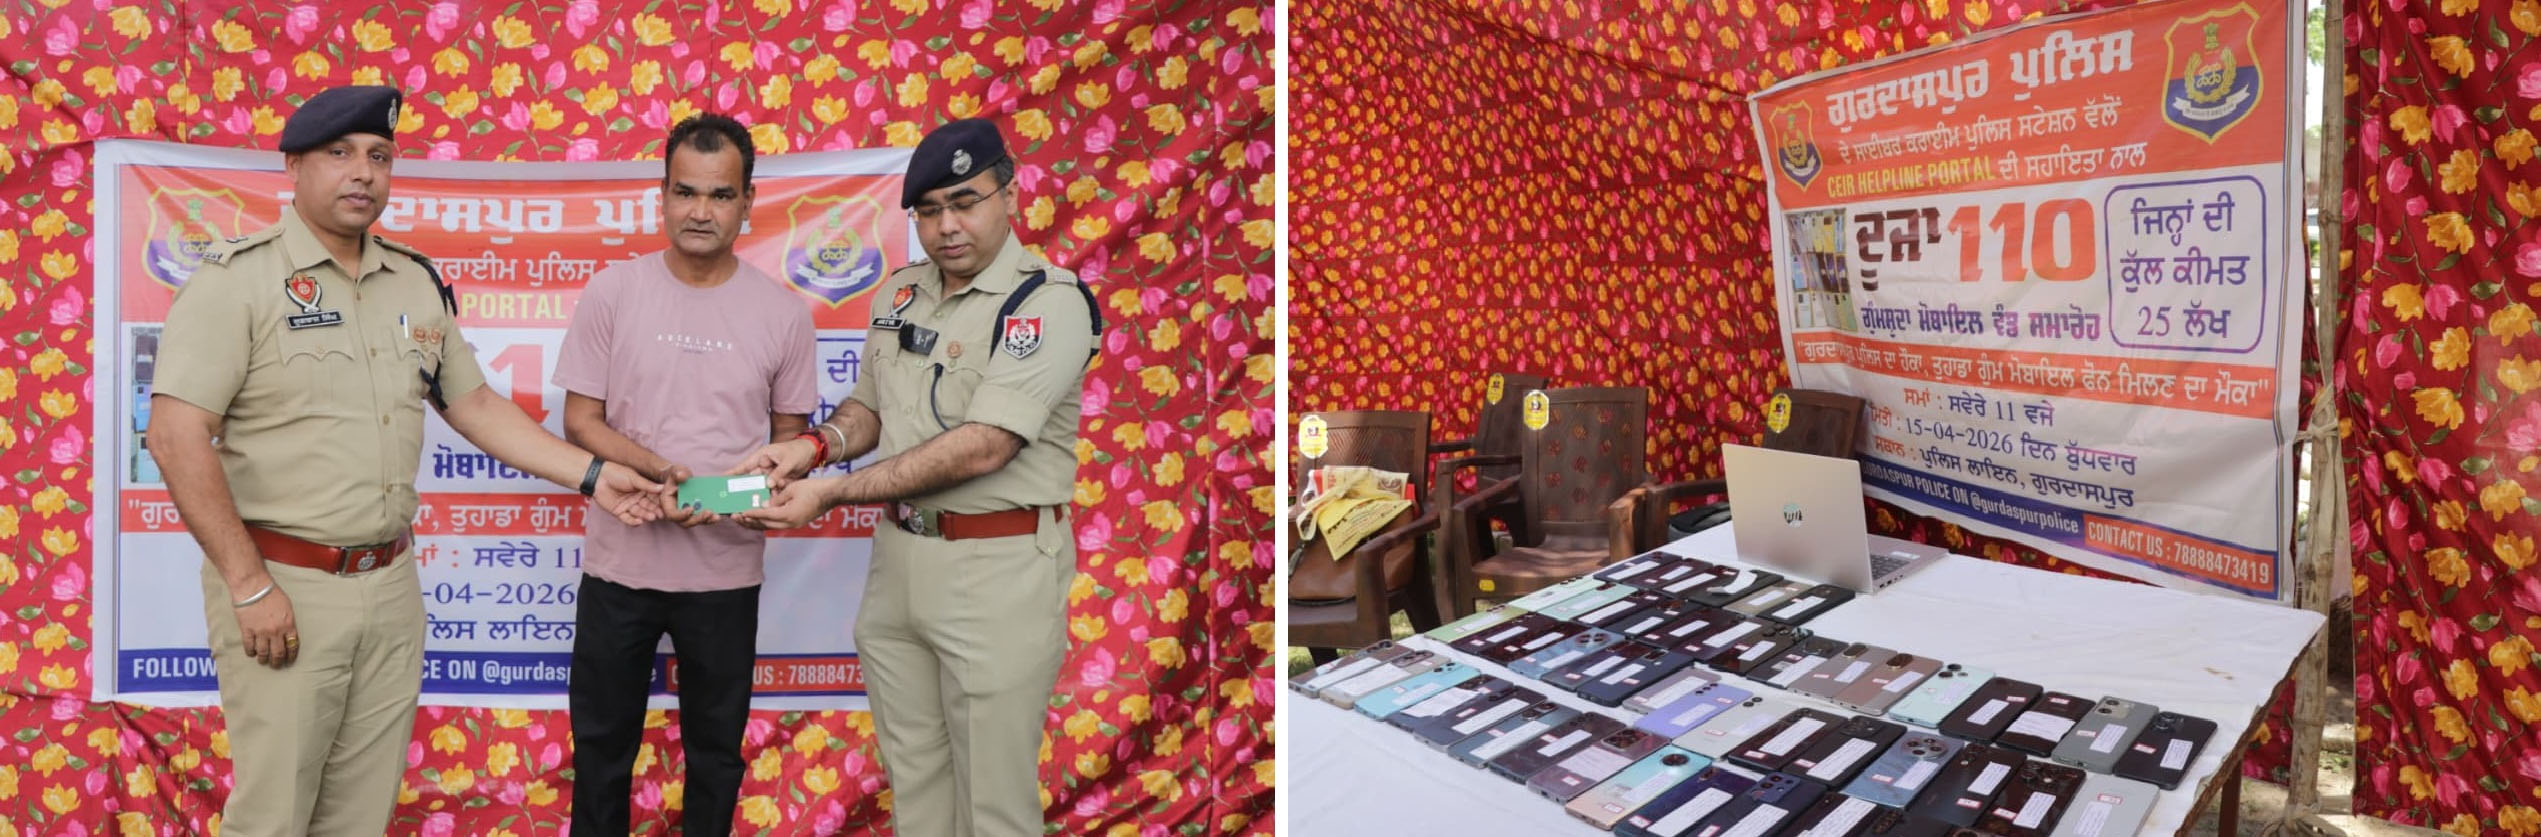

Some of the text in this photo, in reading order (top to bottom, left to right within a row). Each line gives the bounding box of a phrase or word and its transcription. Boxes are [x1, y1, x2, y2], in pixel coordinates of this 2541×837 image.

[1825, 29, 2136, 133] ਗੁਰਦਾਸਪੁਰ ਪੁਲਿਸ
[1852, 131, 1902, 161] ਸਾਈਬਰ
[1904, 121, 1961, 154] ਕਰਾਈਮ
[1964, 114, 2012, 151] ਪੁਲਿਸ
[2016, 104, 2077, 137] ਸਟੇਸ਼ਨ
[1827, 141, 2148, 198] CEIR HELPLINE PORTAL ਦੀ ਸਹਾਇਤਾ ਨਾਲ
[380, 195, 566, 244] ਦਾਸਪੁਰ
[2202, 190, 2236, 232] ਦੀ
[1853, 197, 2097, 292] ਦੂਜਾ 110
[526, 251, 597, 287] ਪੁਲਿਸ
[2119, 246, 2251, 293] ਕੁੱਲ ਕੀਮਤ
[460, 292, 568, 320] PORTAL
[1917, 302, 1984, 335] ਮੋਬਾਇਲ
[1991, 303, 2019, 338] ਵੰਡ
[2027, 304, 2101, 340] ਸਮਾਰੋਹ
[2137, 299, 2232, 339] 25 ਲੱਖ
[826, 350, 860, 383] ਦੀ
[1882, 350, 1897, 370] ਦਾ
[1931, 356, 1973, 380] ਤੁਹਾਡਾ
[1976, 352, 2004, 385] ਗੁੰਮ
[2007, 354, 2075, 388] ਮੋਬਾਇਲ
[2117, 362, 2177, 398] ਮਿਲਣ
[2183, 375, 2208, 400] ਦਾ
[1947, 391, 1987, 418] ਸਵੇਰੇ
[1997, 402, 2015, 421] 11
[2023, 399, 2055, 428] ਵਜੇ
[1905, 417, 2014, 455] 15-04-2026
[2020, 433, 2058, 462] ਦਿਨ
[2064, 439, 2138, 476] ਬੁੱਧਵਾਰ
[1918, 446, 1962, 474] ਪੁਲਿਸ
[2029, 470, 2135, 509] ਗੁਰਦਾਸਪੁਰ
[450, 505, 522, 533] ਤੁਹਾਡਾ
[530, 497, 572, 532] ਗੁੰਮ
[1915, 475, 1952, 501] POLICE
[1952, 485, 1970, 506] ON
[1970, 490, 2079, 534] @gurdaspurpolice
[2088, 521, 2144, 553] CONTACT
[2146, 534, 2164, 558] US
[2173, 541, 2270, 585] 78888473419
[473, 541, 541, 567] ਸਵੇਰੇ
[555, 547, 582, 568] 11
[422, 582, 576, 605] -04-2026
[133, 656, 217, 679] FOLLOW
[448, 659, 476, 680] ON
[788, 664, 864, 685] 78888473
